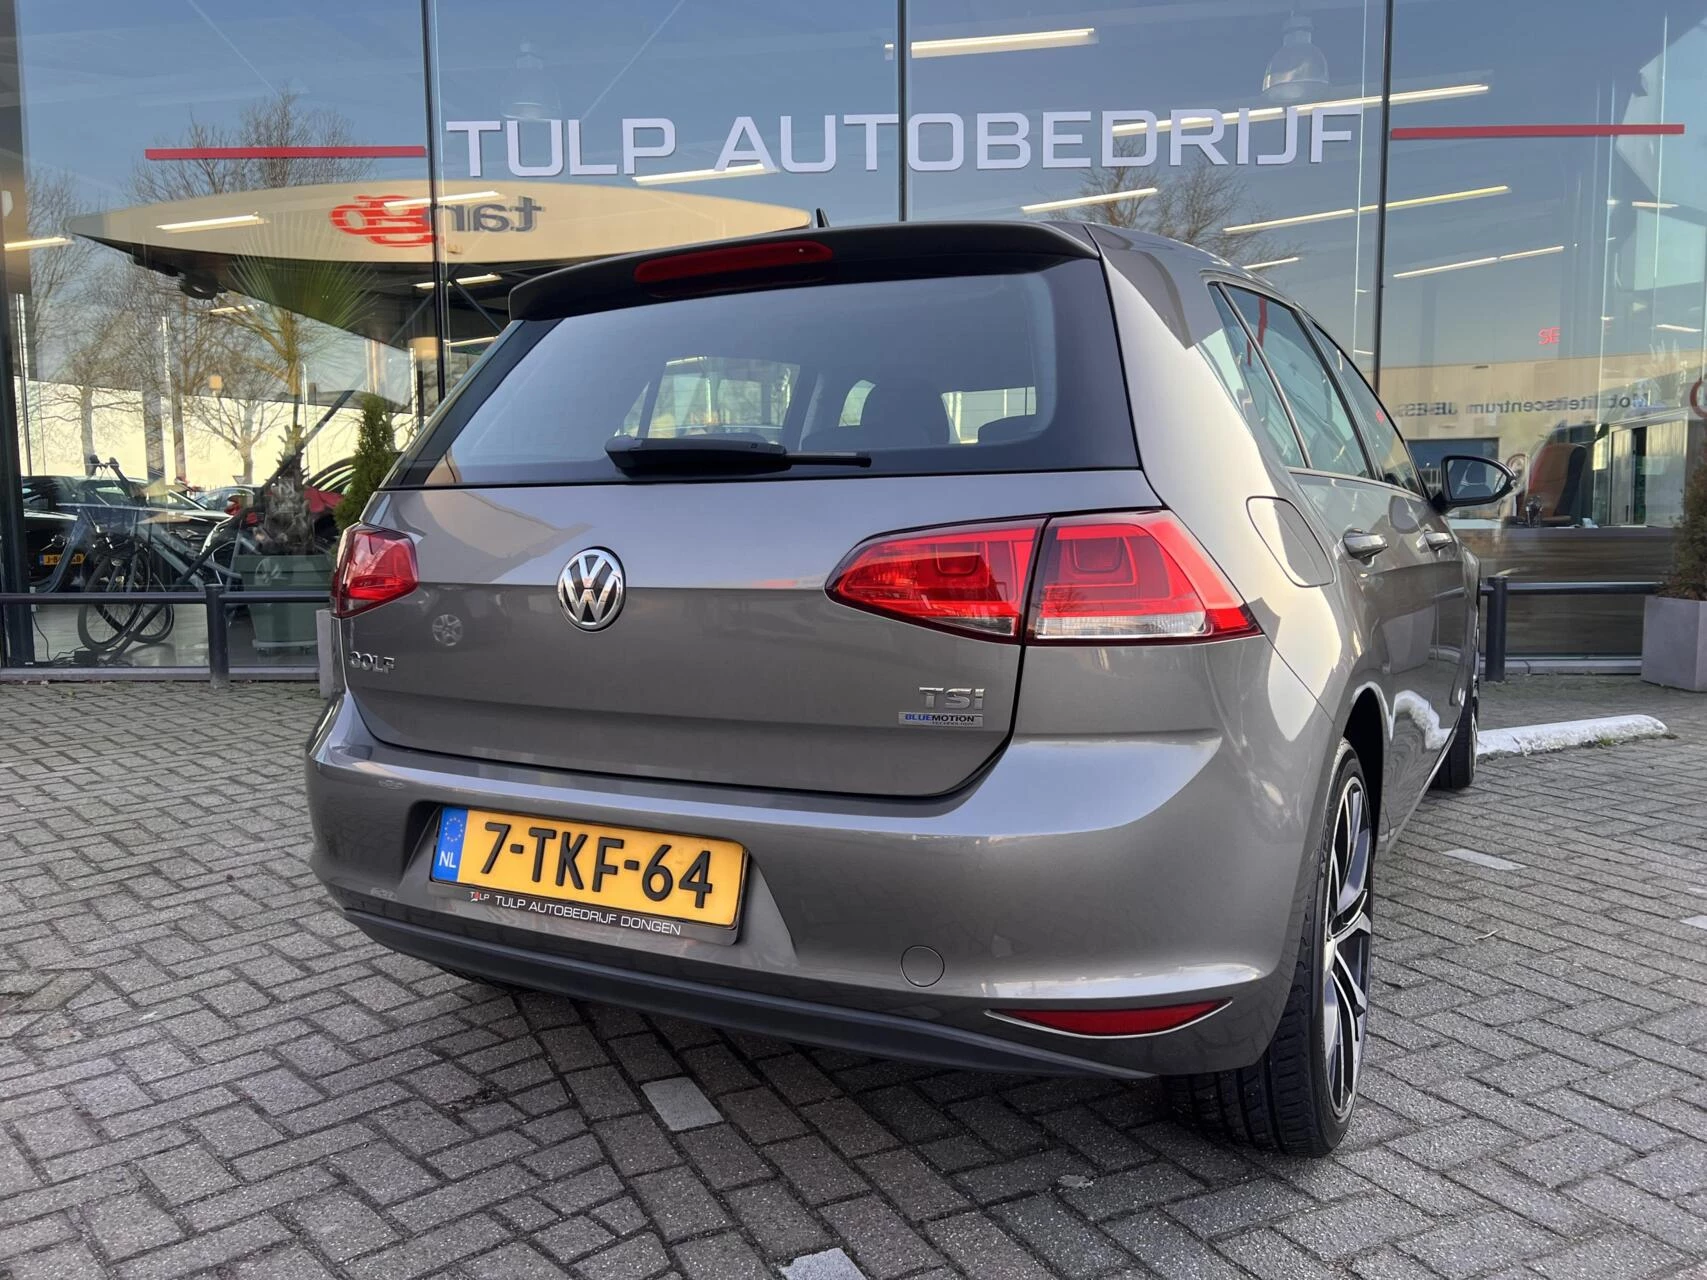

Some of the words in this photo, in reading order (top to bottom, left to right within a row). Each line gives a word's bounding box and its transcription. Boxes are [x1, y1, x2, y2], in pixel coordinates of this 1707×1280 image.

[446, 117, 676, 178] TULP
[713, 106, 1363, 174] AUTOBEDRIJF
[349, 651, 395, 674] GOLF
[919, 687, 985, 710] TSI
[904, 713, 975, 722] BLUEMOTION
[439, 850, 457, 869] NL
[480, 821, 714, 909] 7-TKF-64
[495, 895, 526, 909] TULP
[528, 901, 617, 924] AUTOBEDRIJF
[620, 915, 681, 936] DONGEN
